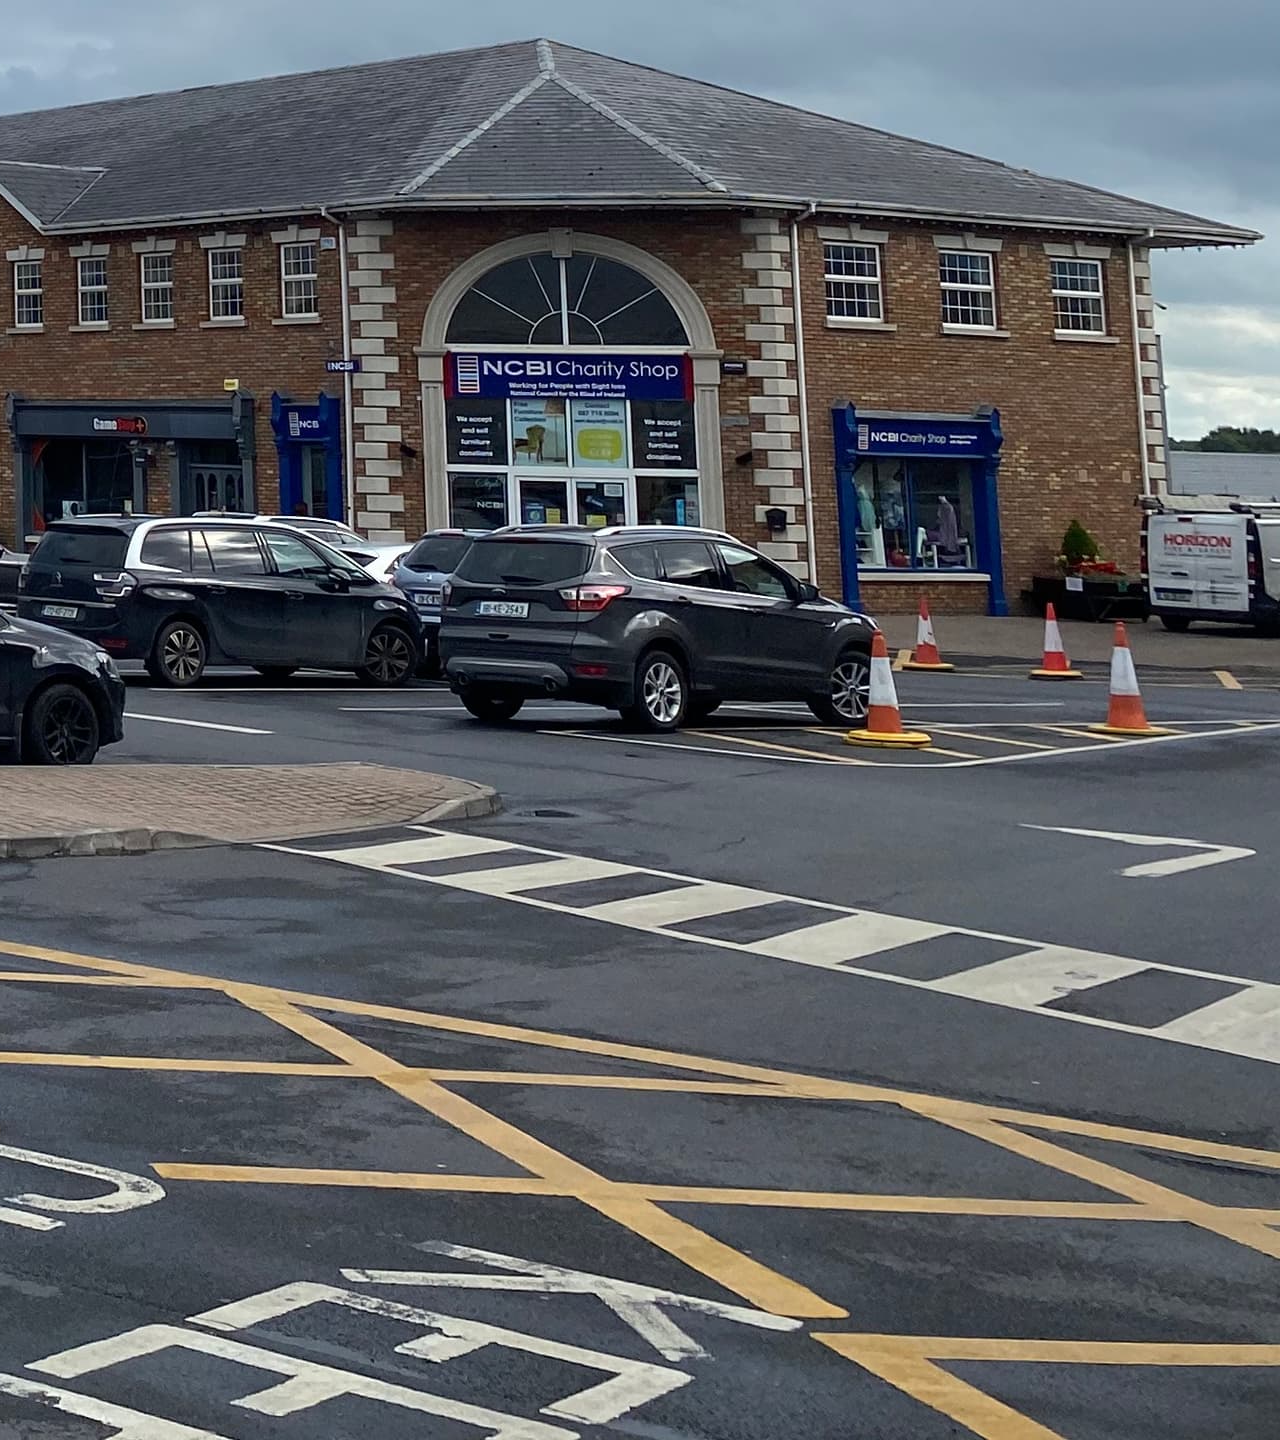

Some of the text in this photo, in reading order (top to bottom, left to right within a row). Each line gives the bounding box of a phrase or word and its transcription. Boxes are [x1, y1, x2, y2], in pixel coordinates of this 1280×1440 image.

[483, 360, 679, 380] NCBI Charity Shop
[508, 382, 537, 390] Working
[299, 421, 320, 429] NCB
[871, 432, 899, 442] NCBI
[900, 433, 926, 446] Charity
[928, 433, 946, 444] Shop
[1164, 533, 1232, 548] HORIZON
